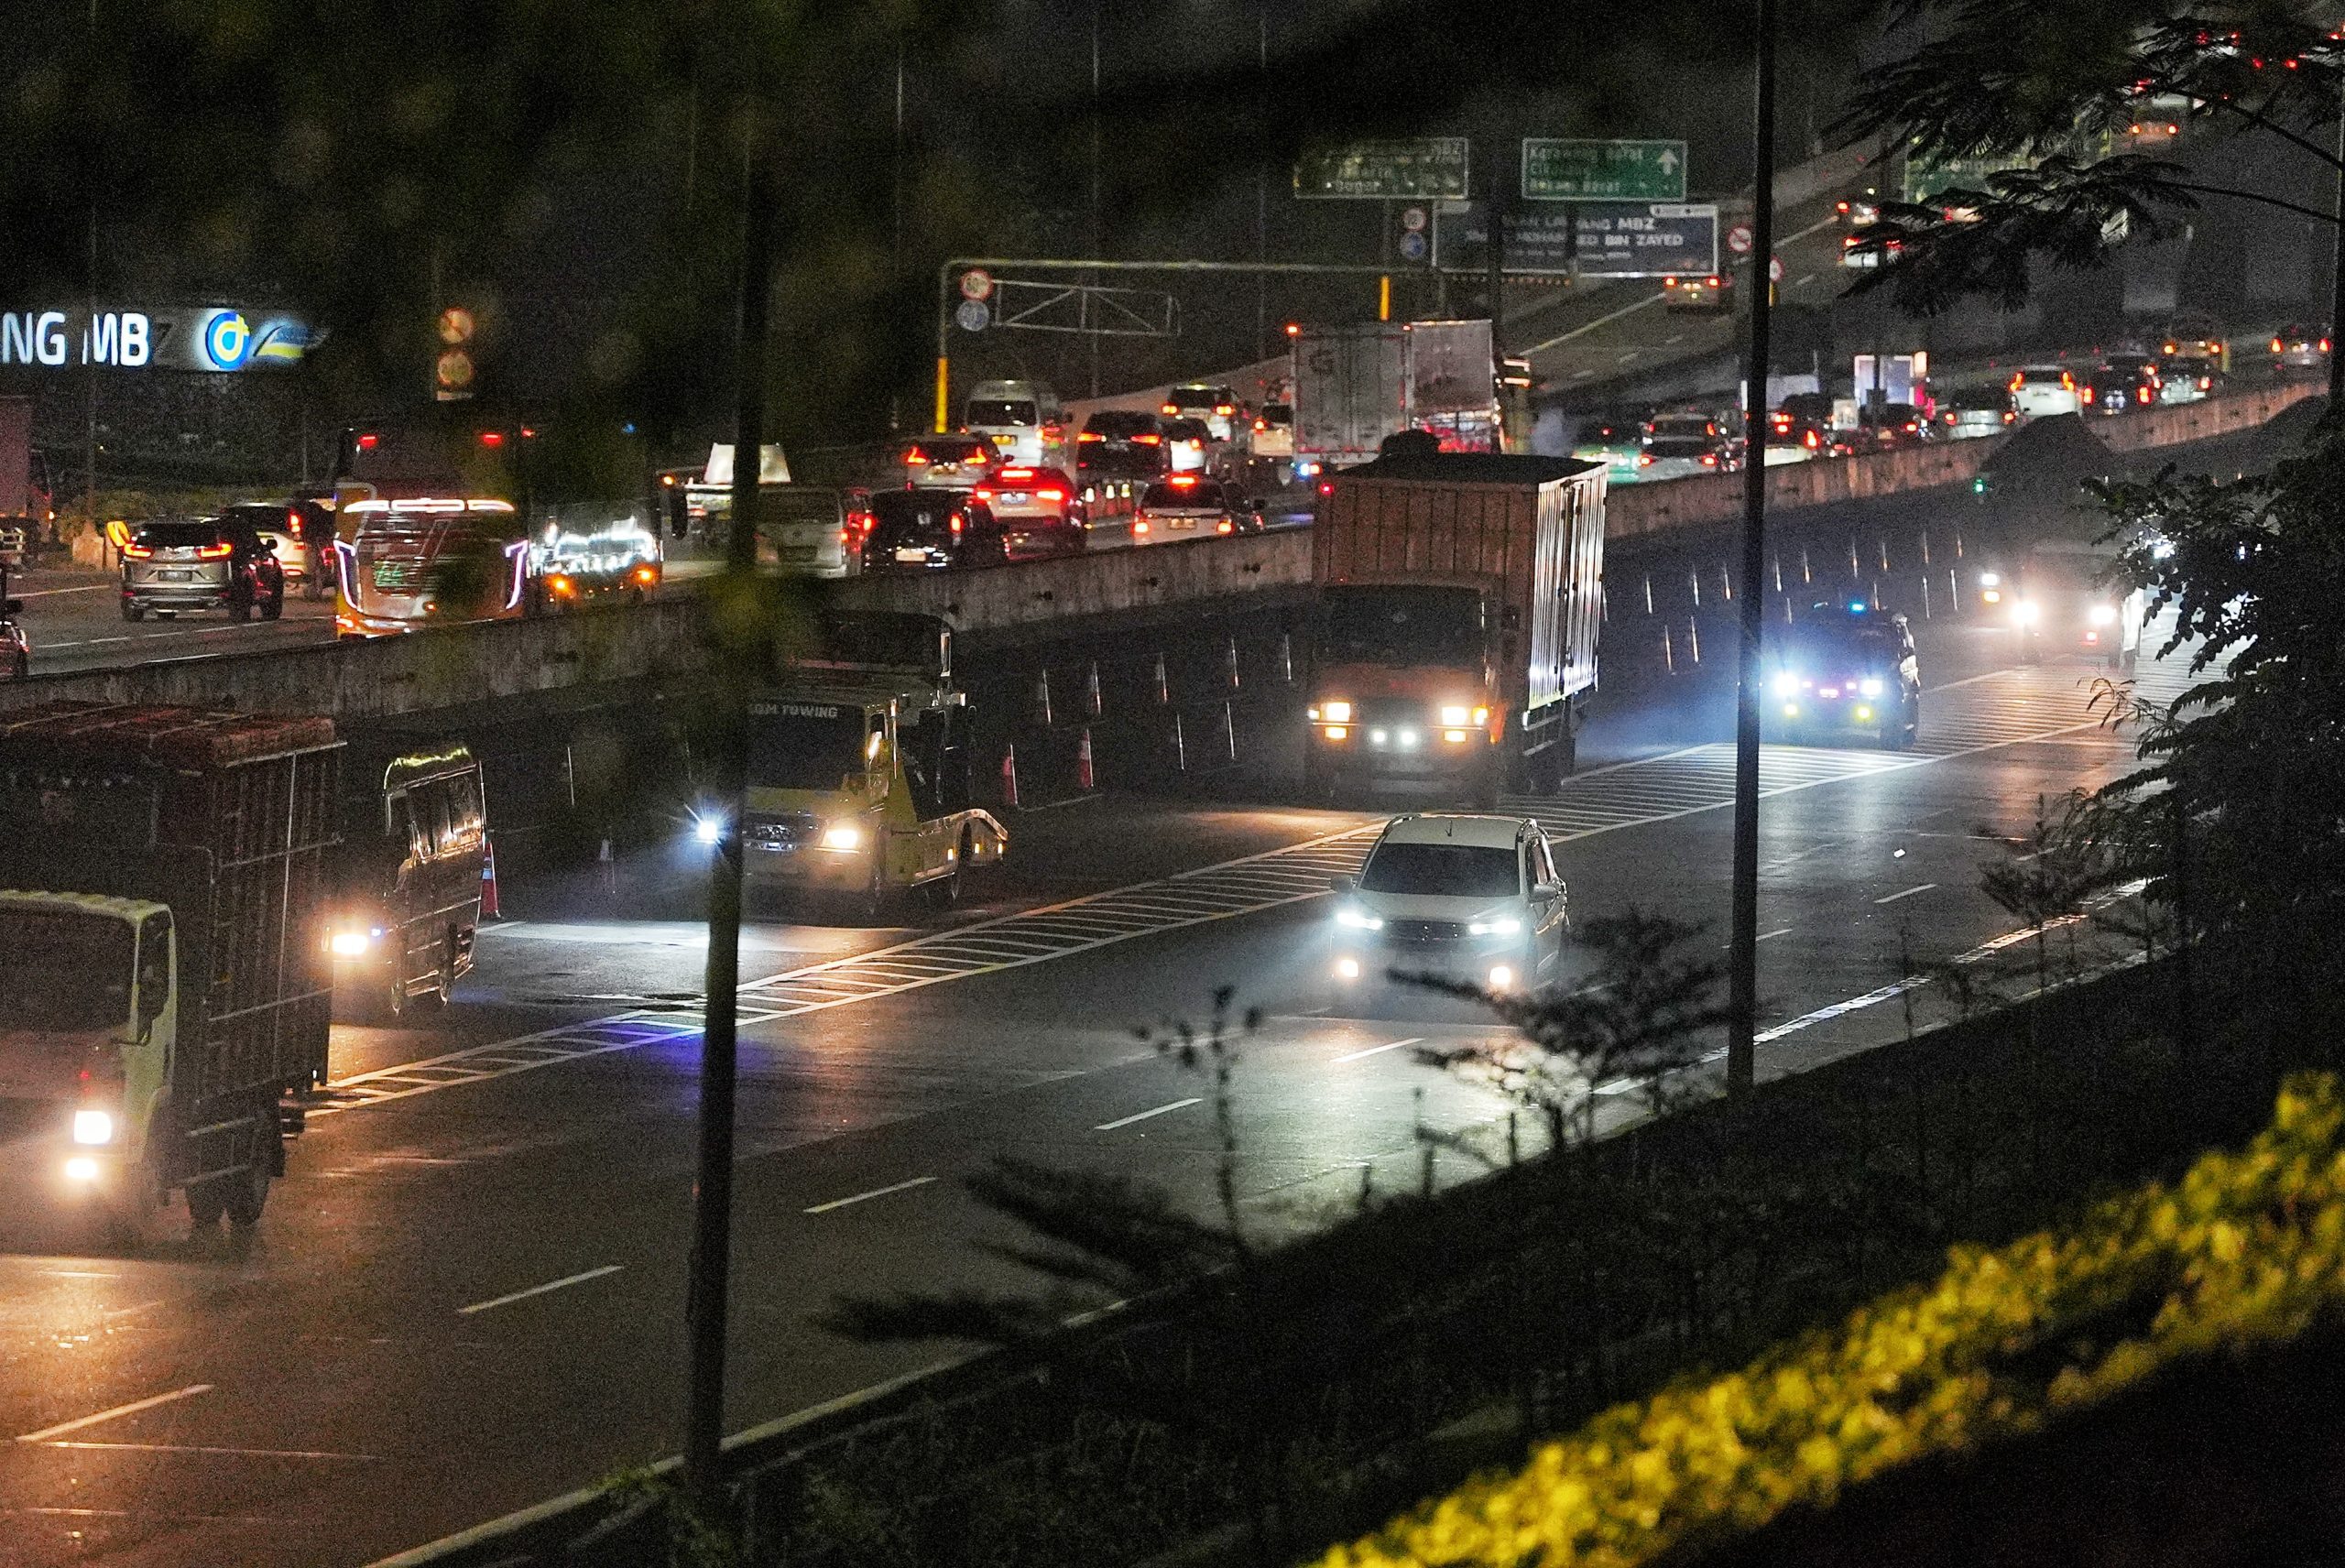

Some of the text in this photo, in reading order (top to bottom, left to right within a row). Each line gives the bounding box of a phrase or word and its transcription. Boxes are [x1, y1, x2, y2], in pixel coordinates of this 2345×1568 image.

[1617, 217, 1655, 232] MBZ
[1636, 234, 1685, 247] ZAYED
[2, 311, 67, 365] NG
[781, 704, 839, 719] TOWING
